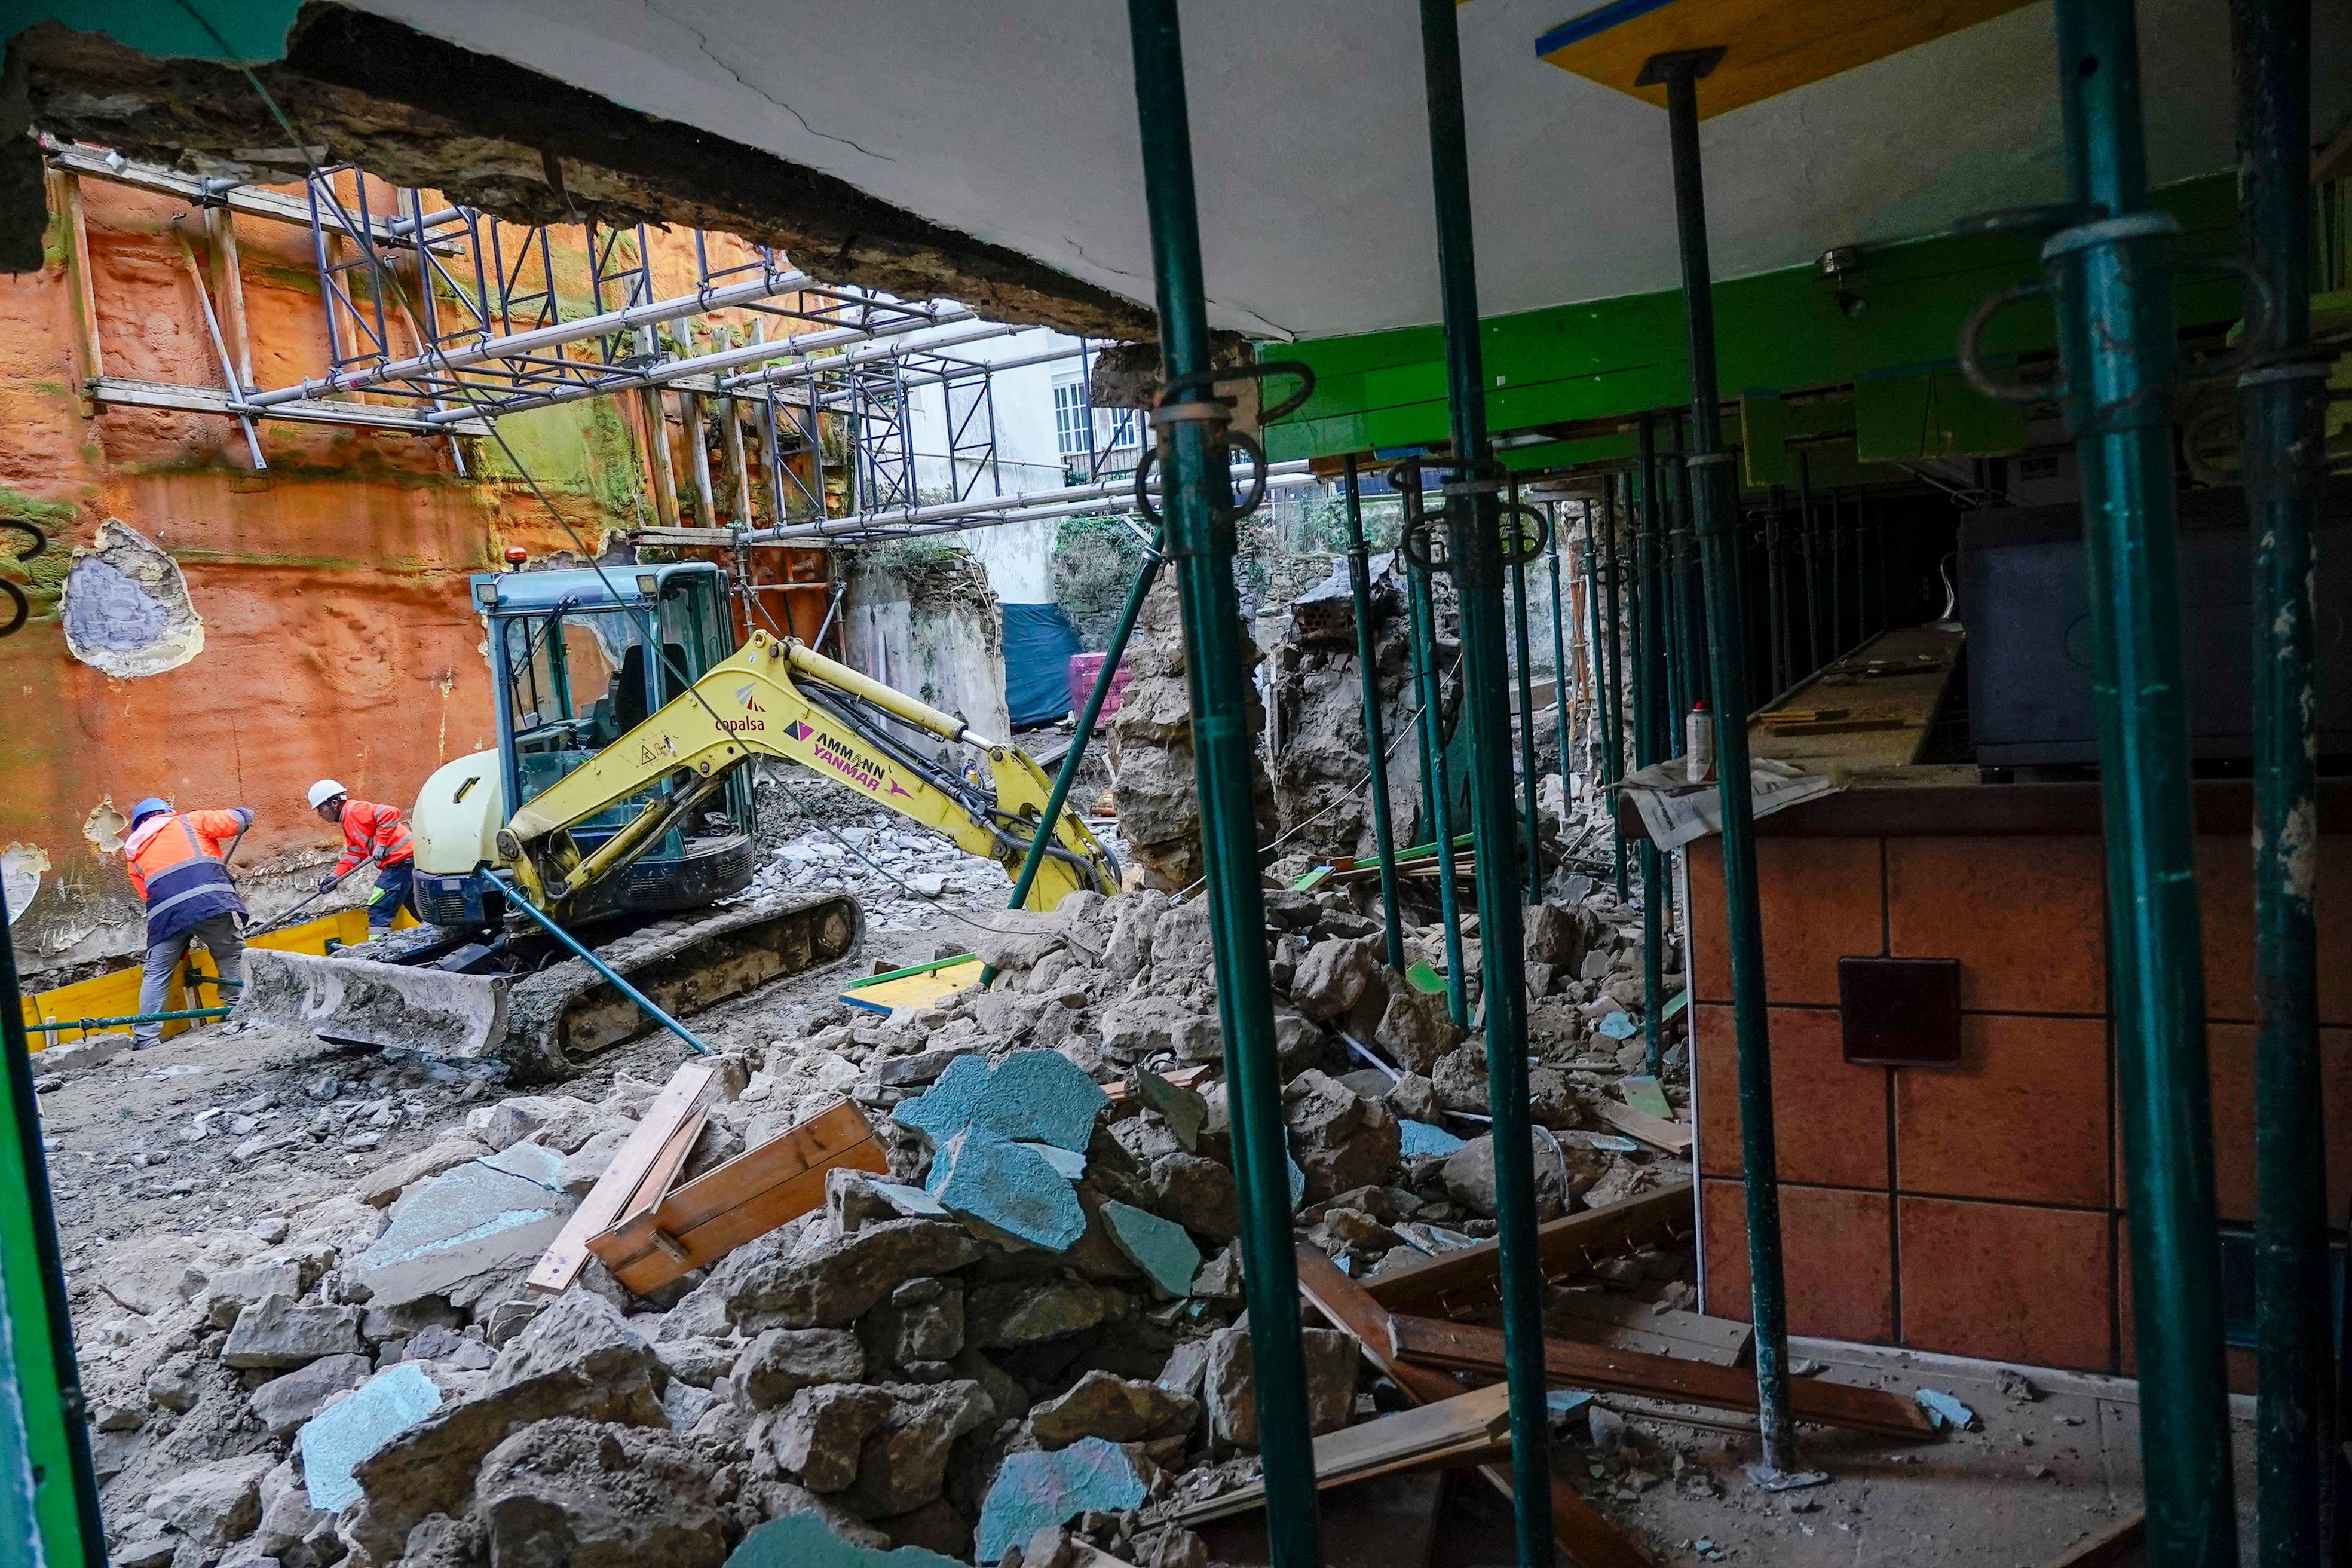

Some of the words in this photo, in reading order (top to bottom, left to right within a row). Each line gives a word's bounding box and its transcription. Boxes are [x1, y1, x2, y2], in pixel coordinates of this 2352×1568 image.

[716, 716, 765, 733] copalsa
[814, 743, 880, 791] YANMAR
[816, 733, 886, 780] AMMANN
